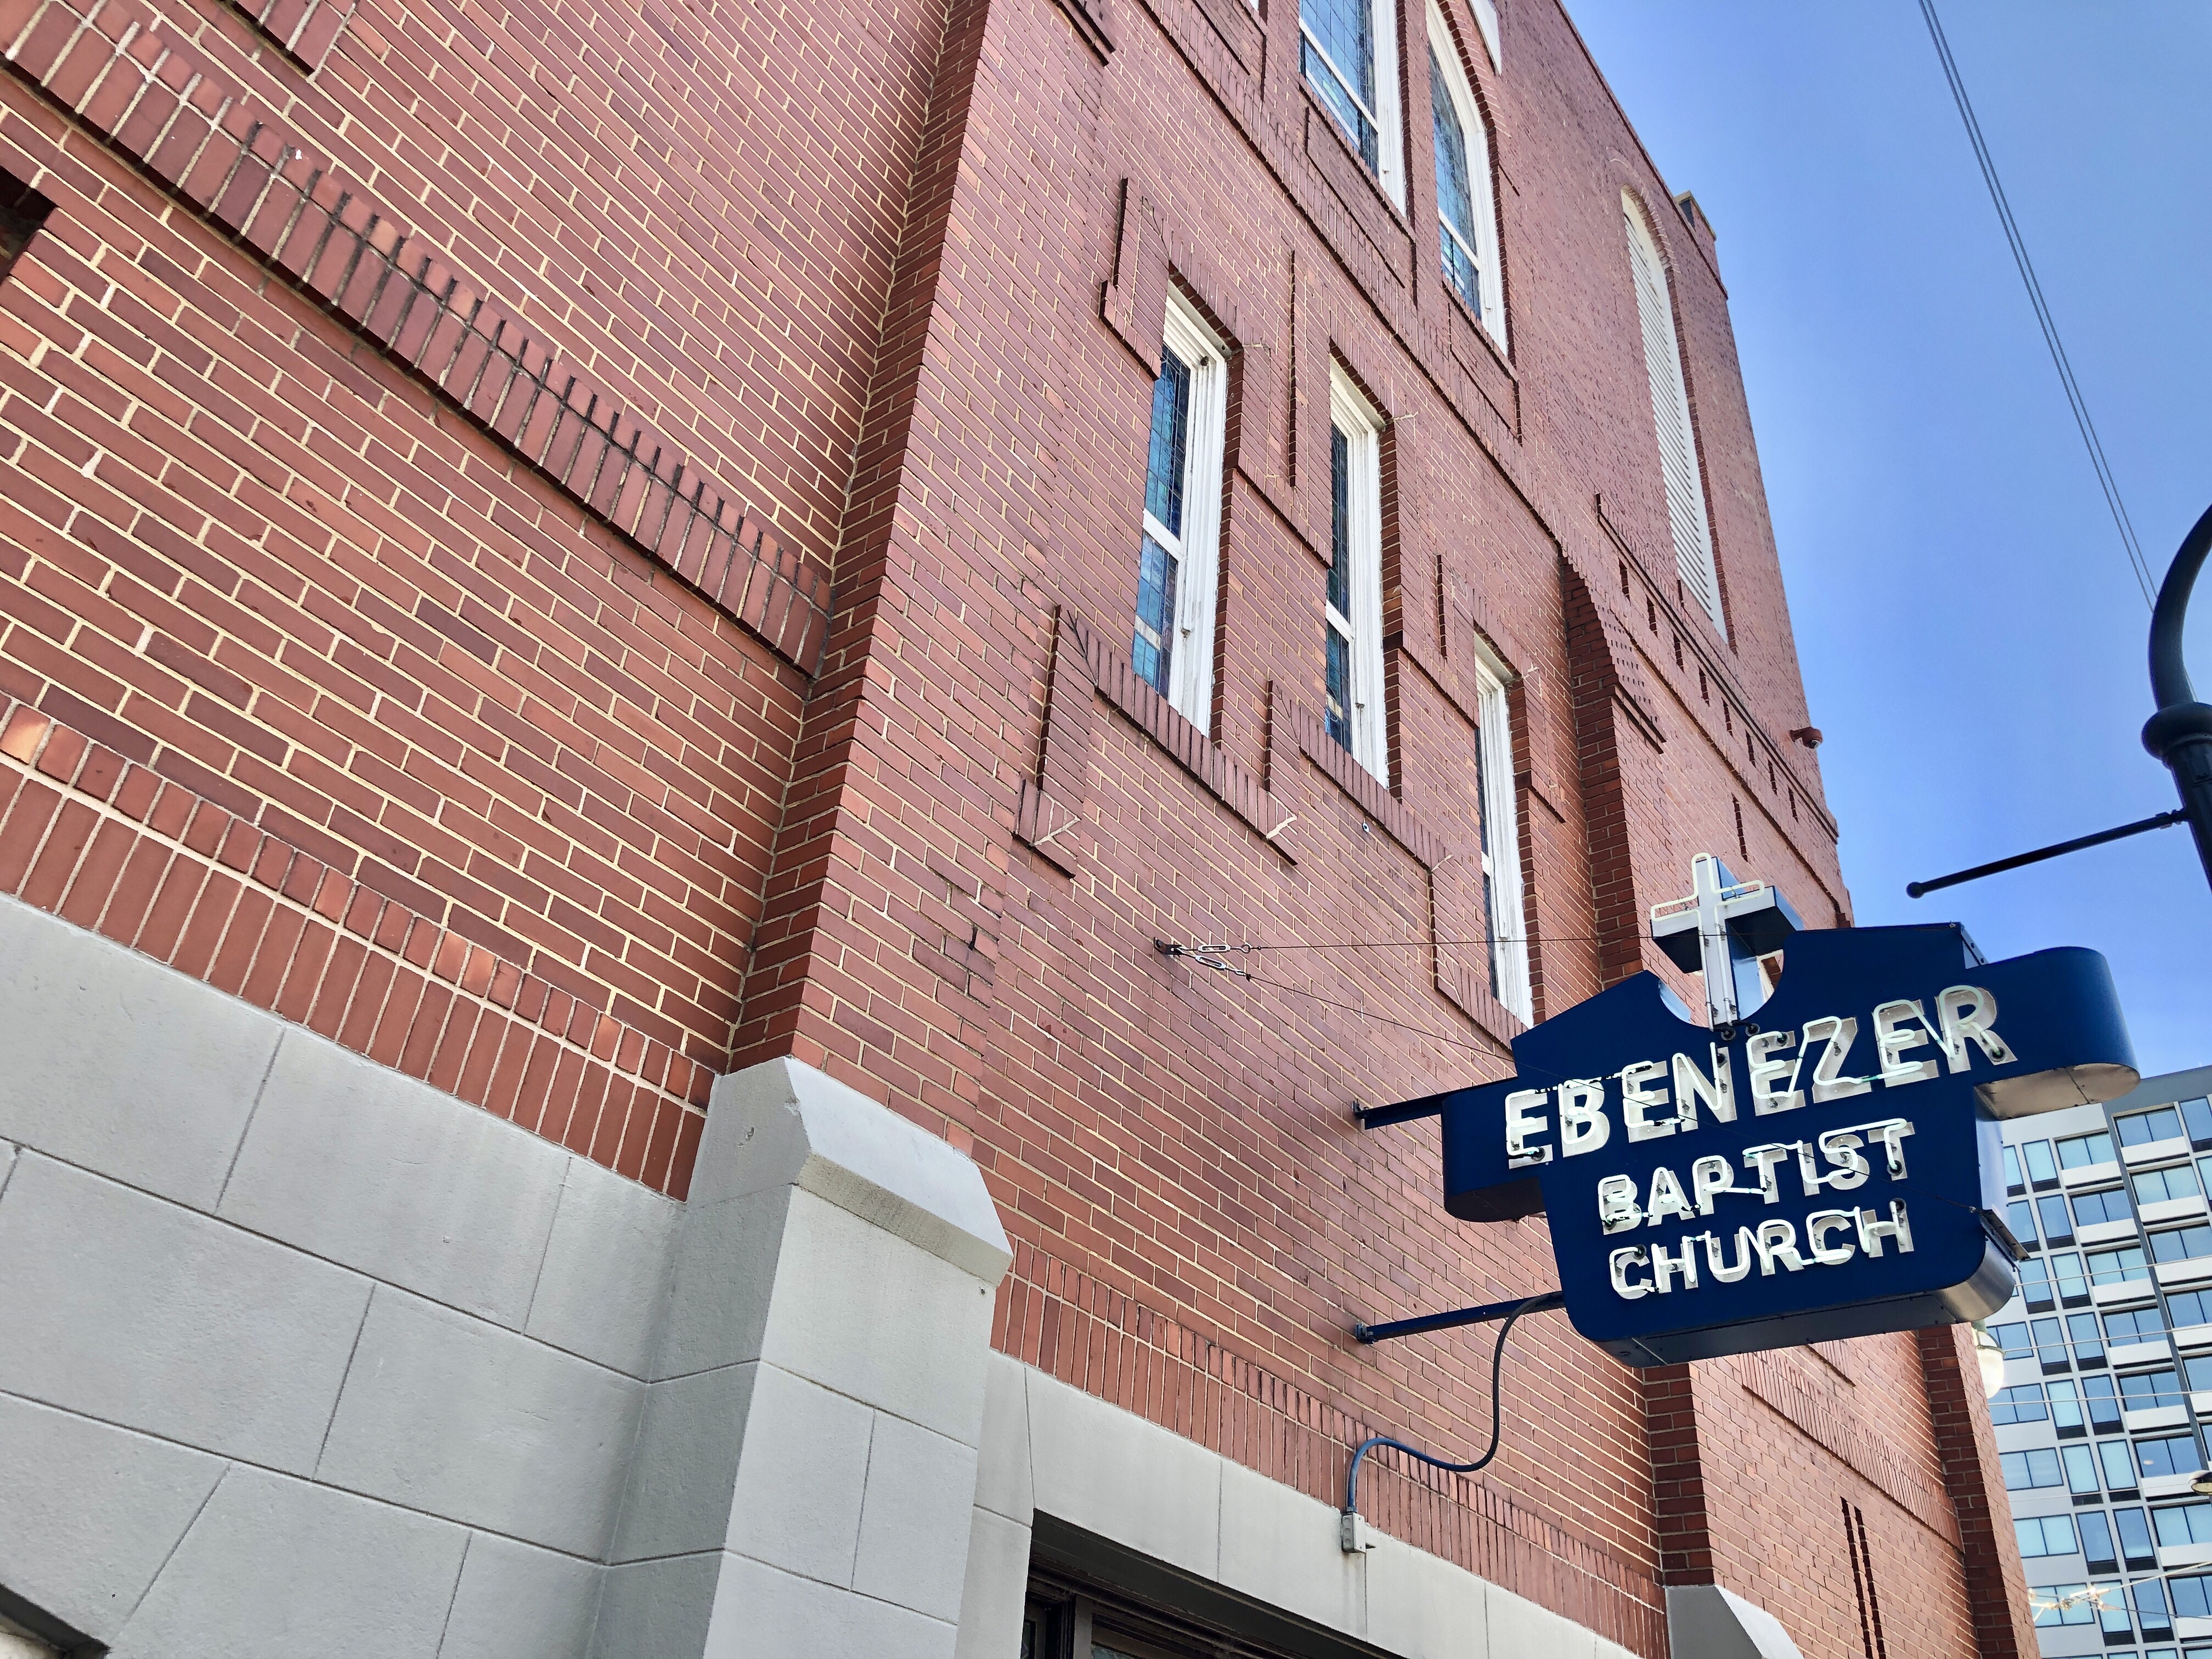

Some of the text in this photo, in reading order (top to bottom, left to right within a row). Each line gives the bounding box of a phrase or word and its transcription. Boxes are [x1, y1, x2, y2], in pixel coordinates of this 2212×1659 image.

[1505, 985, 2017, 1168] EBENEZER
[1598, 1118, 1915, 1234] BAPTIST
[1610, 1199, 1914, 1299] CHURCH
